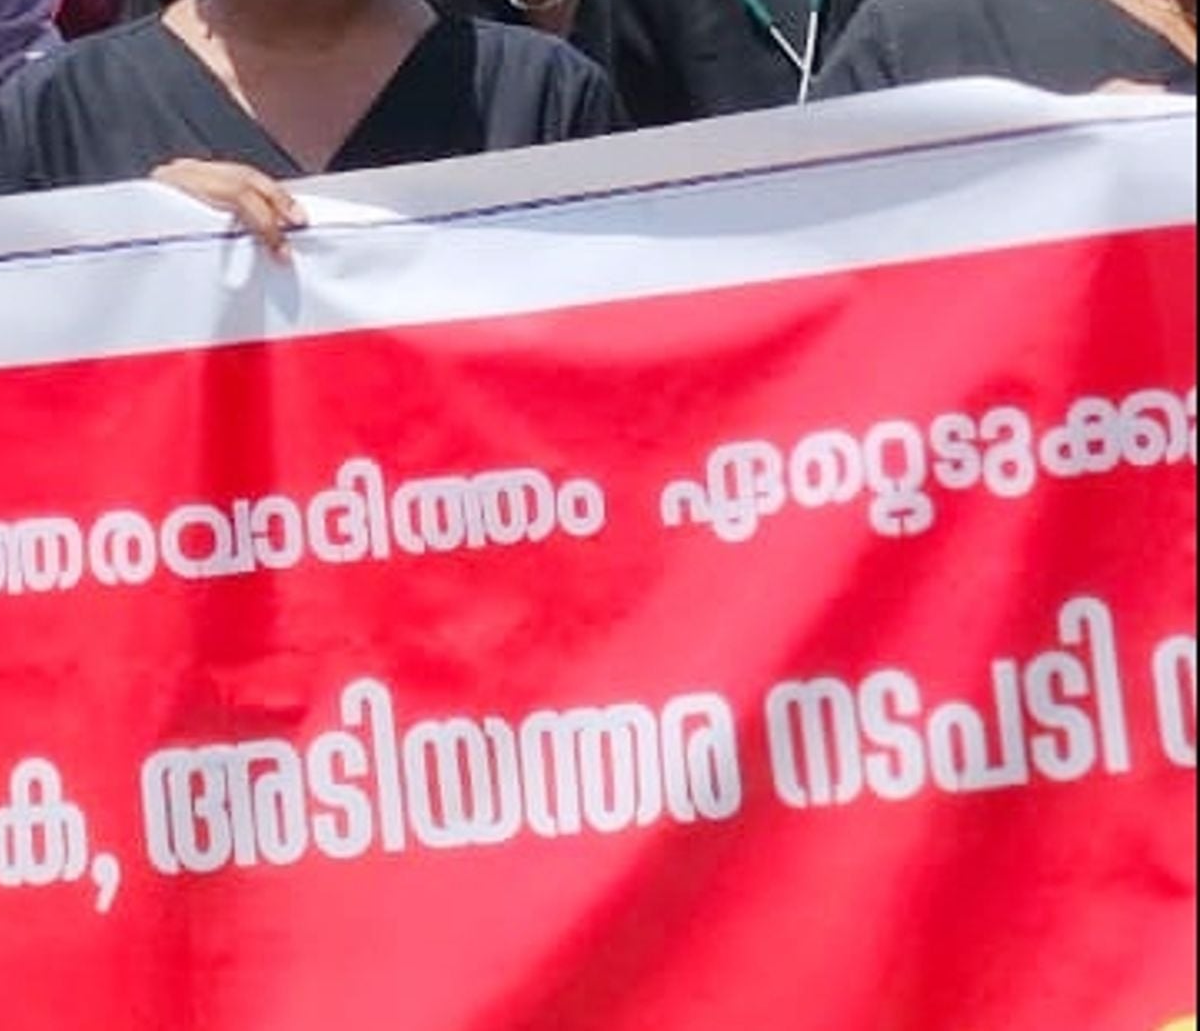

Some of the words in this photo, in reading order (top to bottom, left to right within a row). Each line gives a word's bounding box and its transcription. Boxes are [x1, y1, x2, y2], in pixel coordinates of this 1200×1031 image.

[660, 386, 1197, 544] ഏറ്റെടുക്ക
[140, 676, 742, 874] അടിയന്തര
[764, 596, 1131, 808] നടപടി
